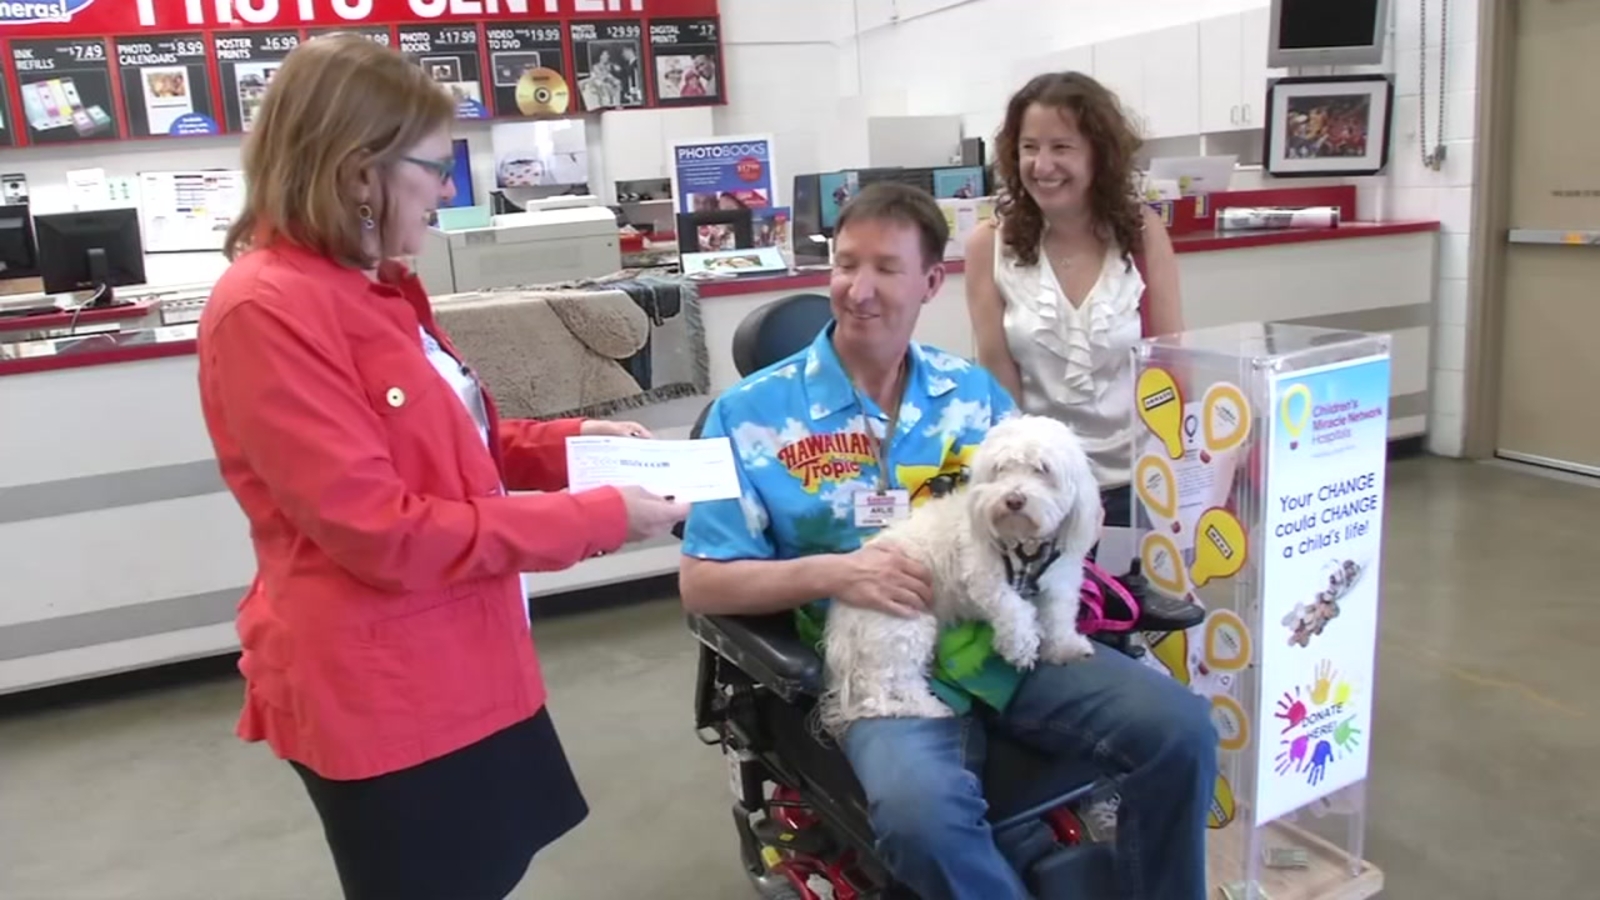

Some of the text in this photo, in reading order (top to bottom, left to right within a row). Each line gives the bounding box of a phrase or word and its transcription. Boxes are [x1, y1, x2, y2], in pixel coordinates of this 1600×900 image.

[400, 32, 431, 42] PHOTO
[486, 29, 514, 39] VIDEO
[117, 43, 152, 55] PHOTO
[215, 38, 252, 49] POSTER
[488, 39, 521, 49] TO DVD
[120, 53, 177, 65] CALENDARS
[217, 48, 251, 59] PRINTS
[15, 58, 55, 70] REFILLS
[793, 456, 860, 488] Tropic
[1280, 472, 1375, 513] Your CHANGE
[1275, 494, 1378, 538] could CHANGE
[1282, 545, 1294, 559] a
[1298, 529, 1341, 554] child's
[1301, 701, 1344, 728] DONATE
